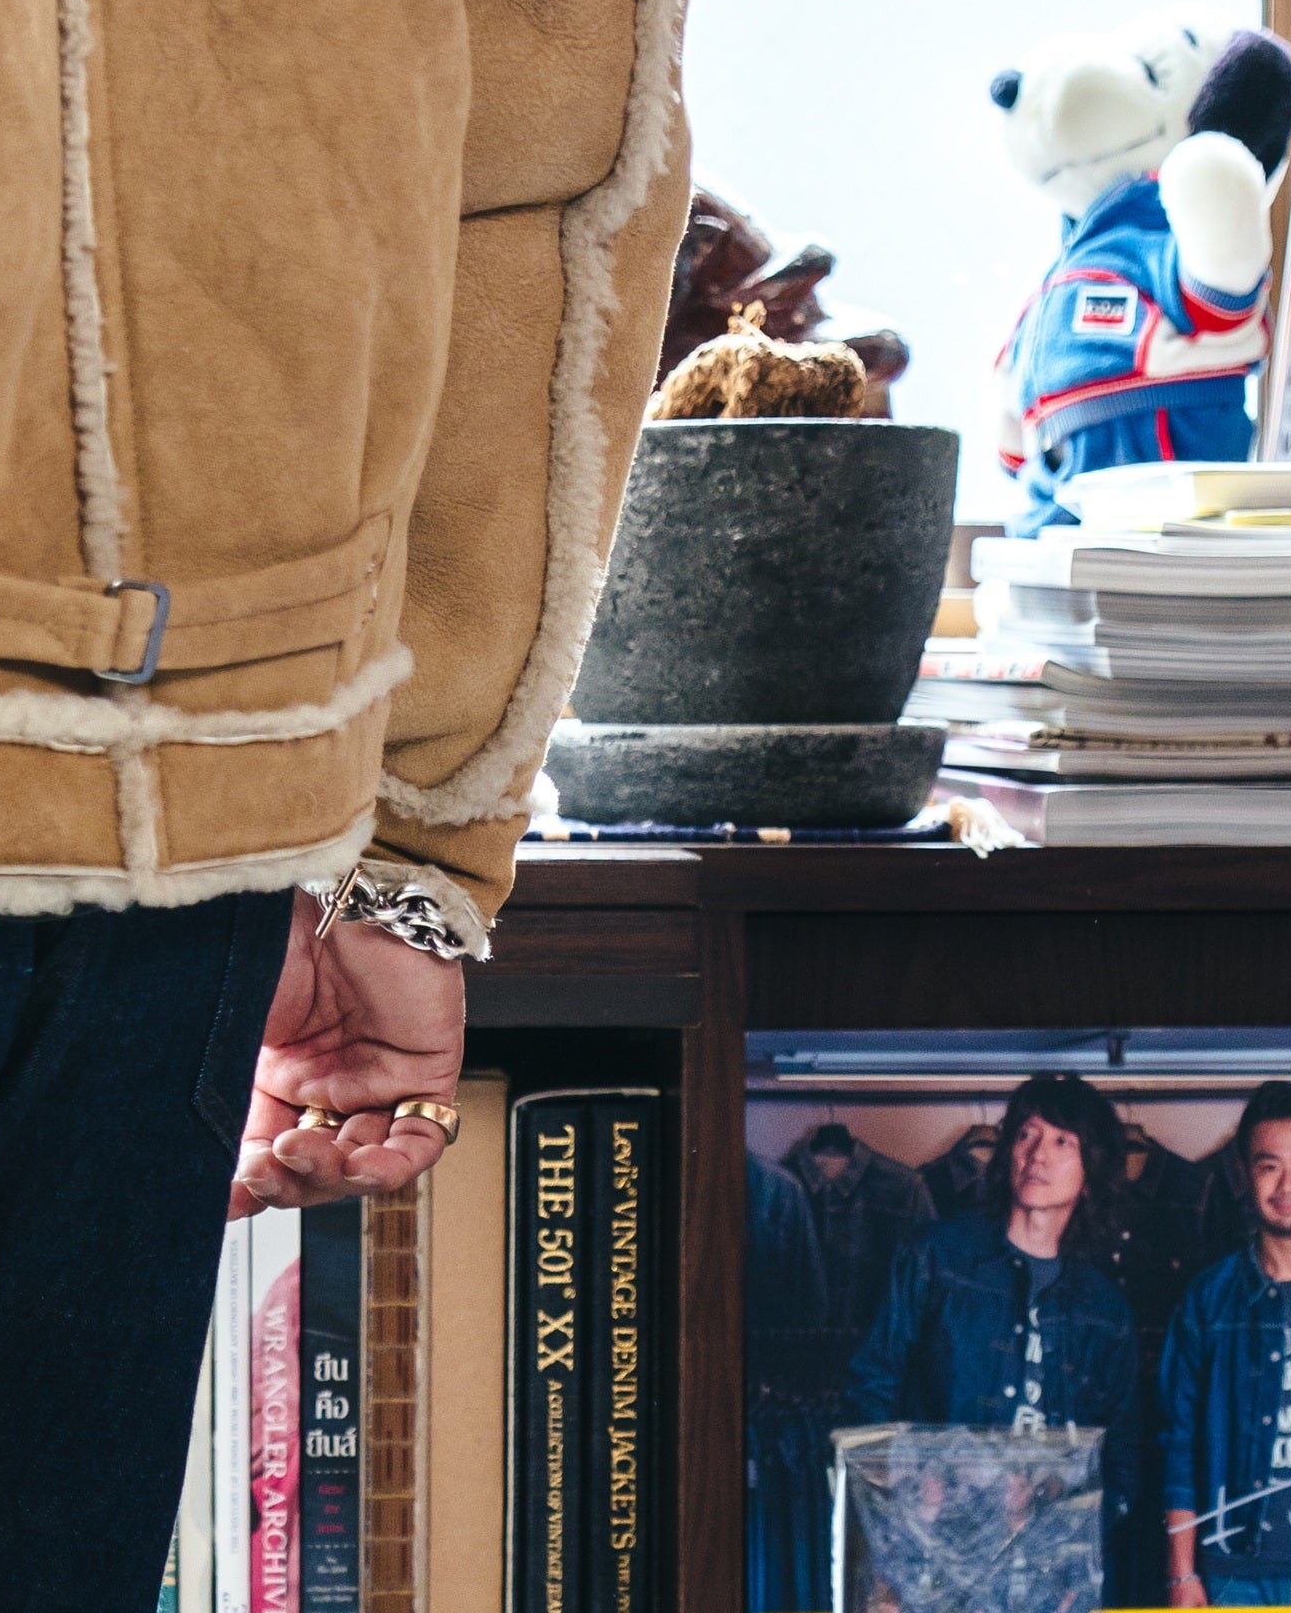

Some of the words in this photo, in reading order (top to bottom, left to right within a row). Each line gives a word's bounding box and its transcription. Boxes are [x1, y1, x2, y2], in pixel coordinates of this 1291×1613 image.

[537, 1123, 576, 1219] THE
[611, 1198, 638, 1320] VINTAGE
[536, 1308, 575, 1373] XX
[610, 1325, 638, 1420] DENIM
[261, 1304, 289, 1479] WRANGLER
[547, 1393, 564, 1488] COLLECTION
[608, 1426, 638, 1550] JACKETS
[546, 1511, 564, 1580] VINTAGE
